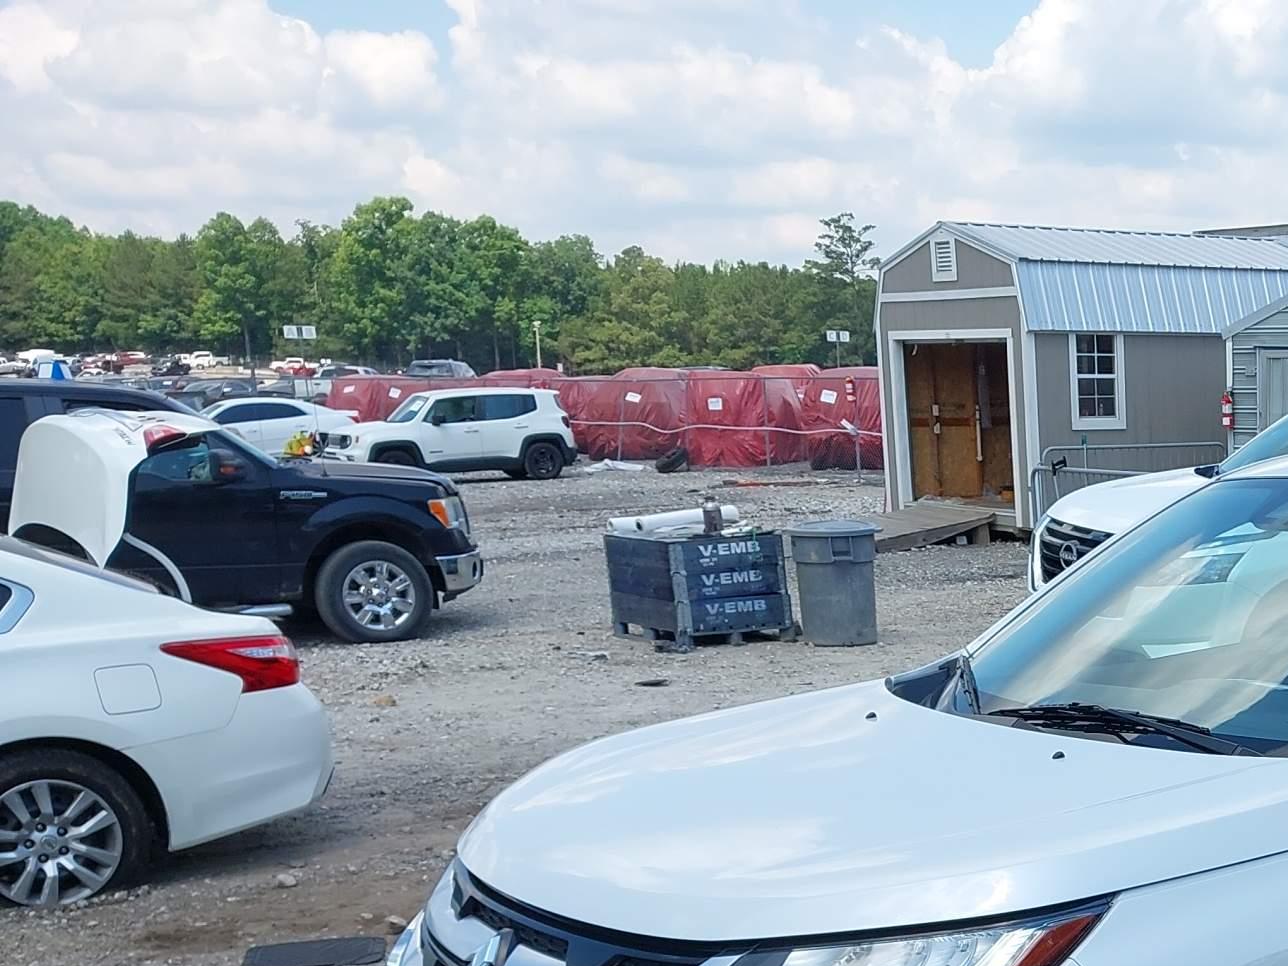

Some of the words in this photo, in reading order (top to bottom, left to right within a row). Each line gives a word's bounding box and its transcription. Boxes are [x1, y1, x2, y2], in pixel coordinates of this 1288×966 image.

[698, 540, 761, 557] V-EMB
[701, 569, 763, 586] V-EMB
[706, 599, 767, 615] V-EMB
